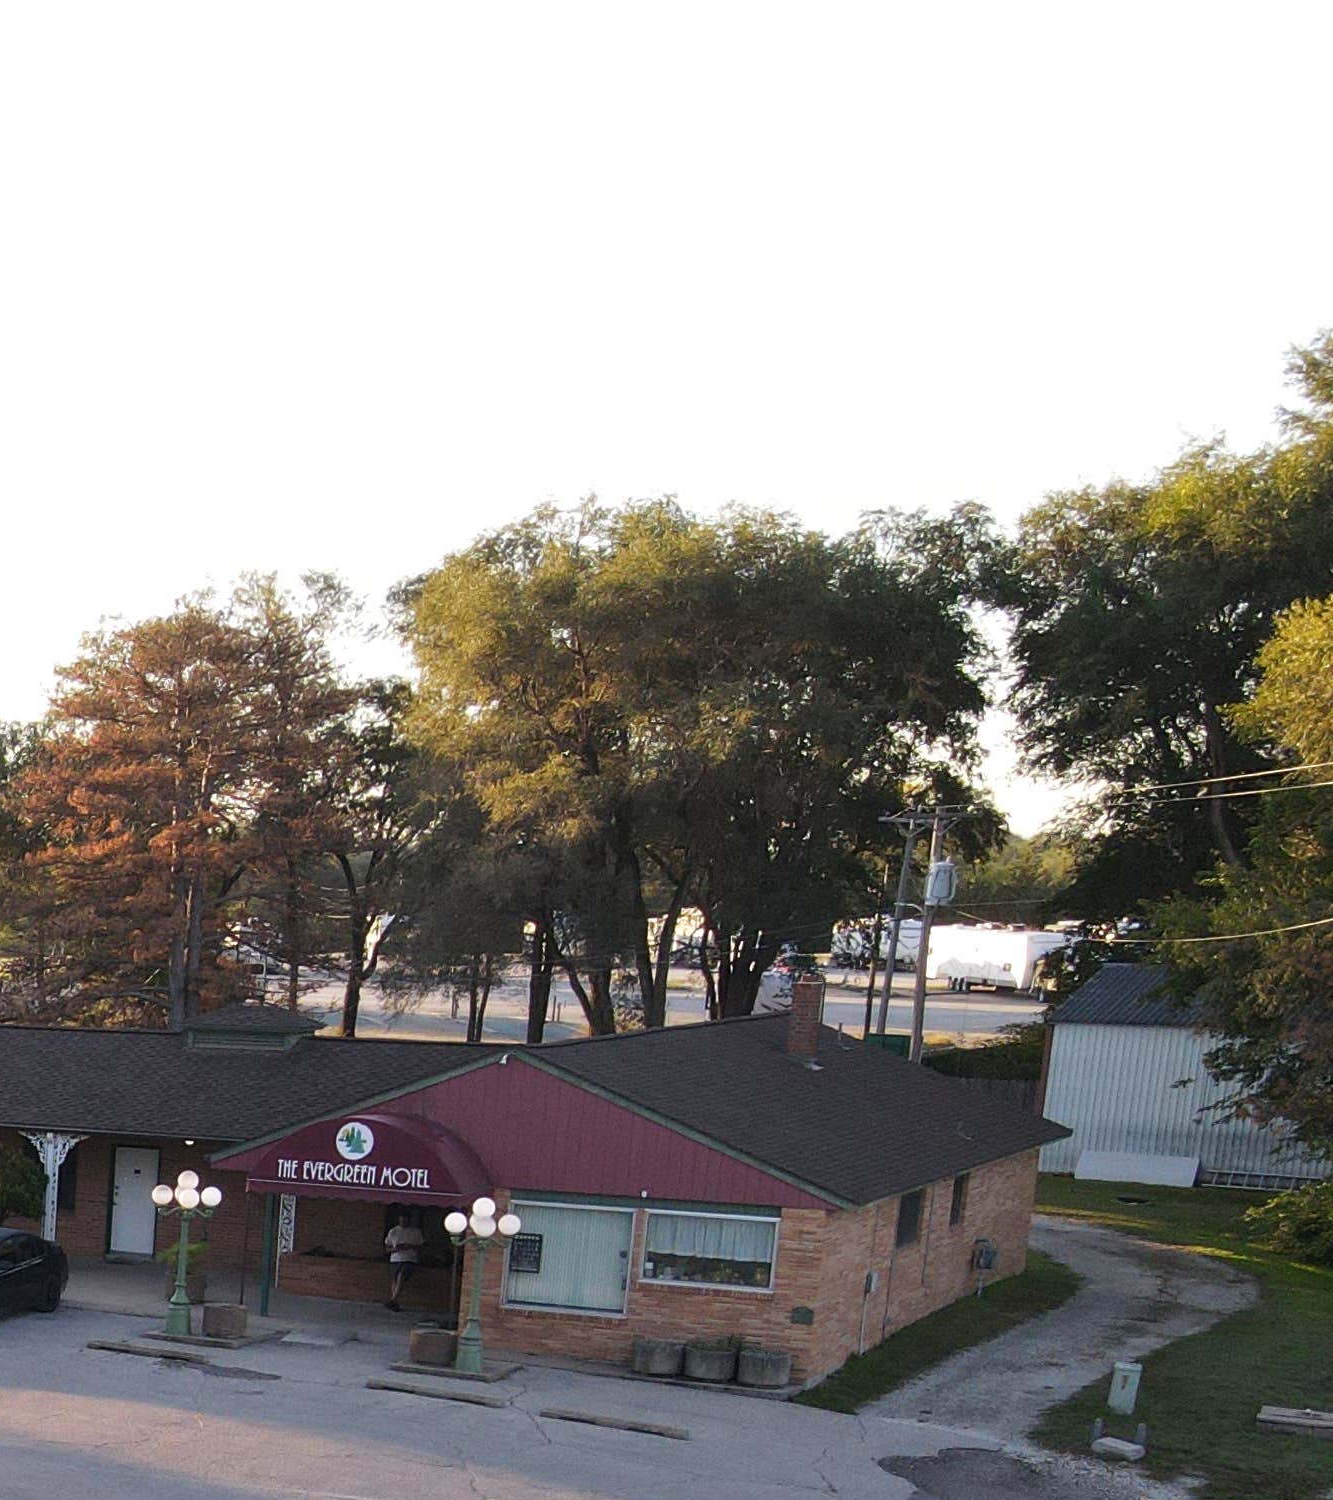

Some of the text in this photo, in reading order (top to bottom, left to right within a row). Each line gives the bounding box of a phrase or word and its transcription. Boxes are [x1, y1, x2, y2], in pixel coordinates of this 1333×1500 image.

[277, 1159, 430, 1188] THE EVERGREEN MOTEL
